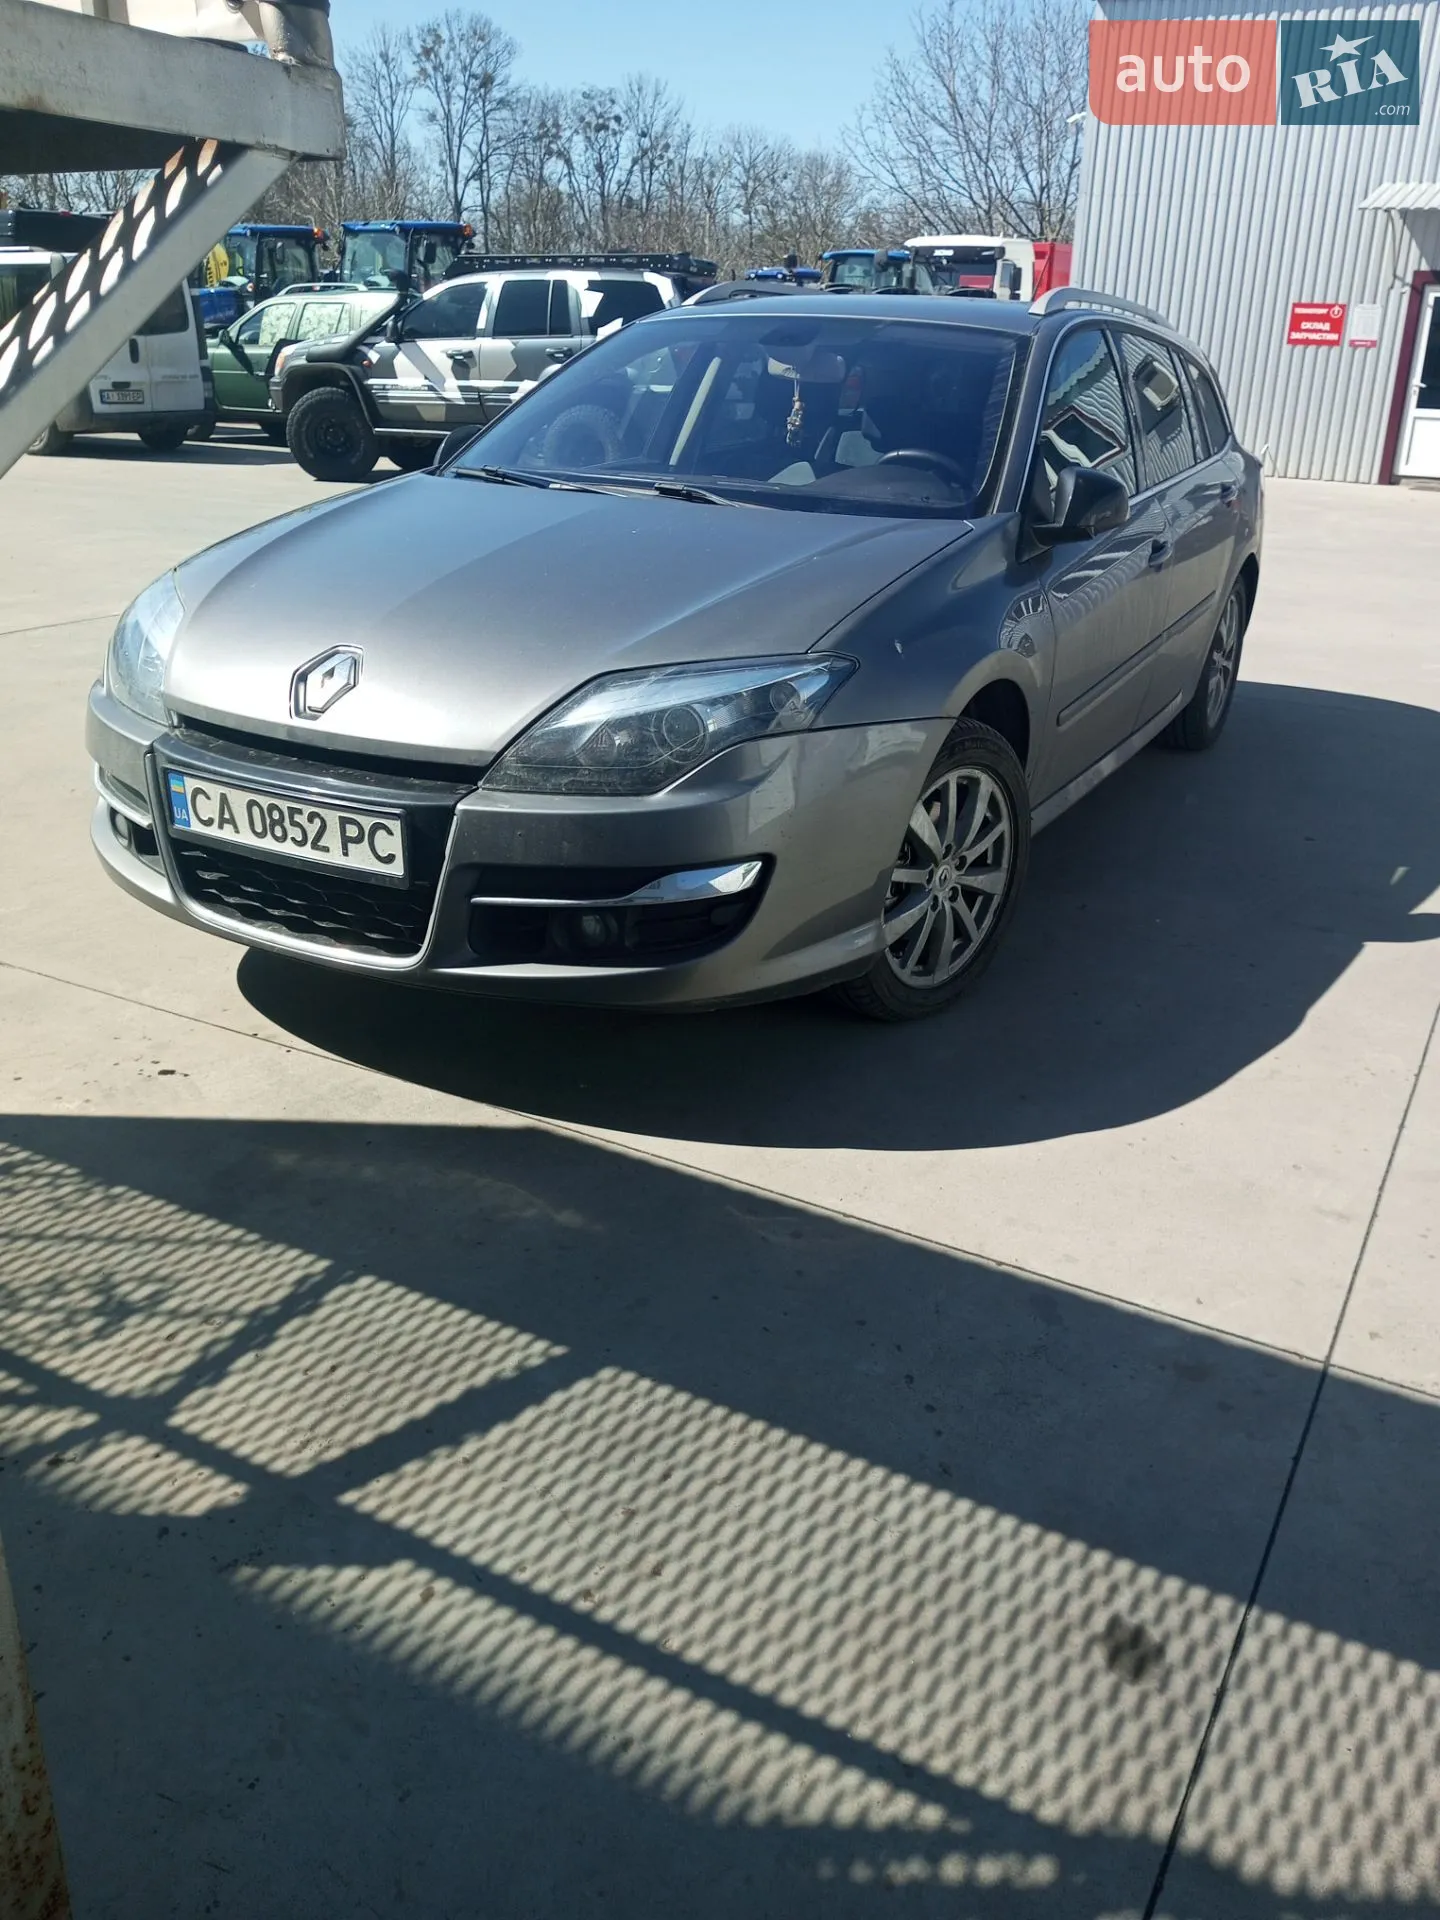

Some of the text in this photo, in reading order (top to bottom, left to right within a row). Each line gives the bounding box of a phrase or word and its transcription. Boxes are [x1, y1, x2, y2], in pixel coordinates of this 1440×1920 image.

[1301, 321, 1331, 331] СКЛАД
[174, 808, 189, 822] UA
[190, 787, 396, 865] CA 0852 PC
